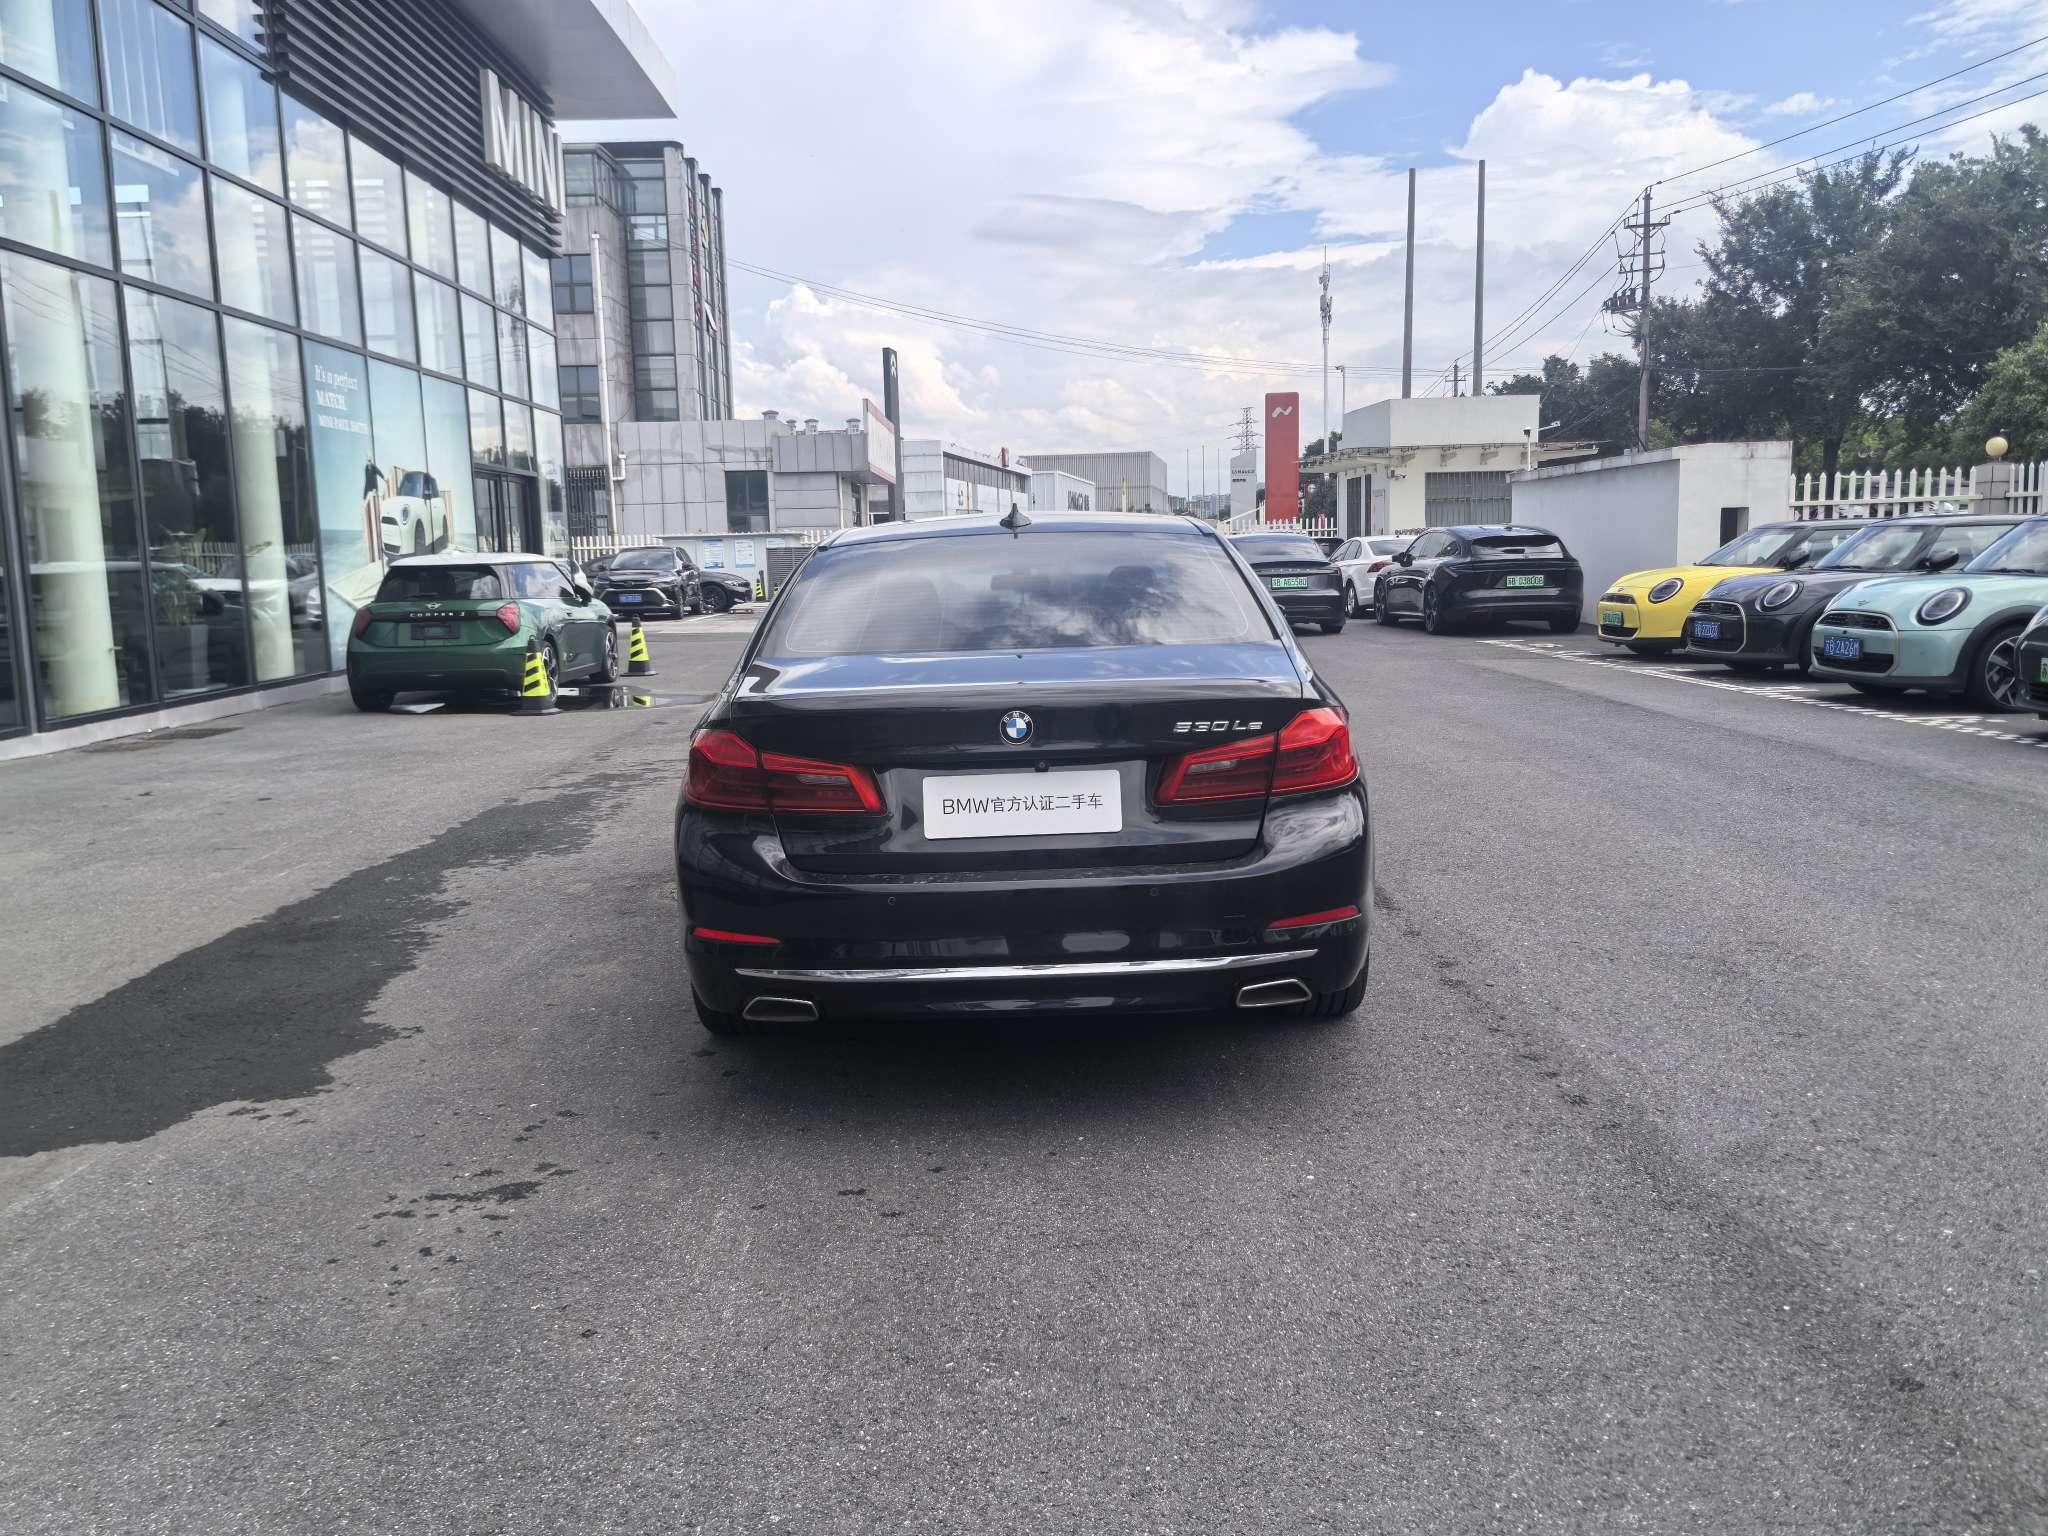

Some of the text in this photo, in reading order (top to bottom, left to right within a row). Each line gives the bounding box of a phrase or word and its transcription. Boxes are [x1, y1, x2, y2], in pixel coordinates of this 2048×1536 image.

[480, 69, 567, 216] MINI
[942, 793, 1103, 815] BMW官方认证二手车
